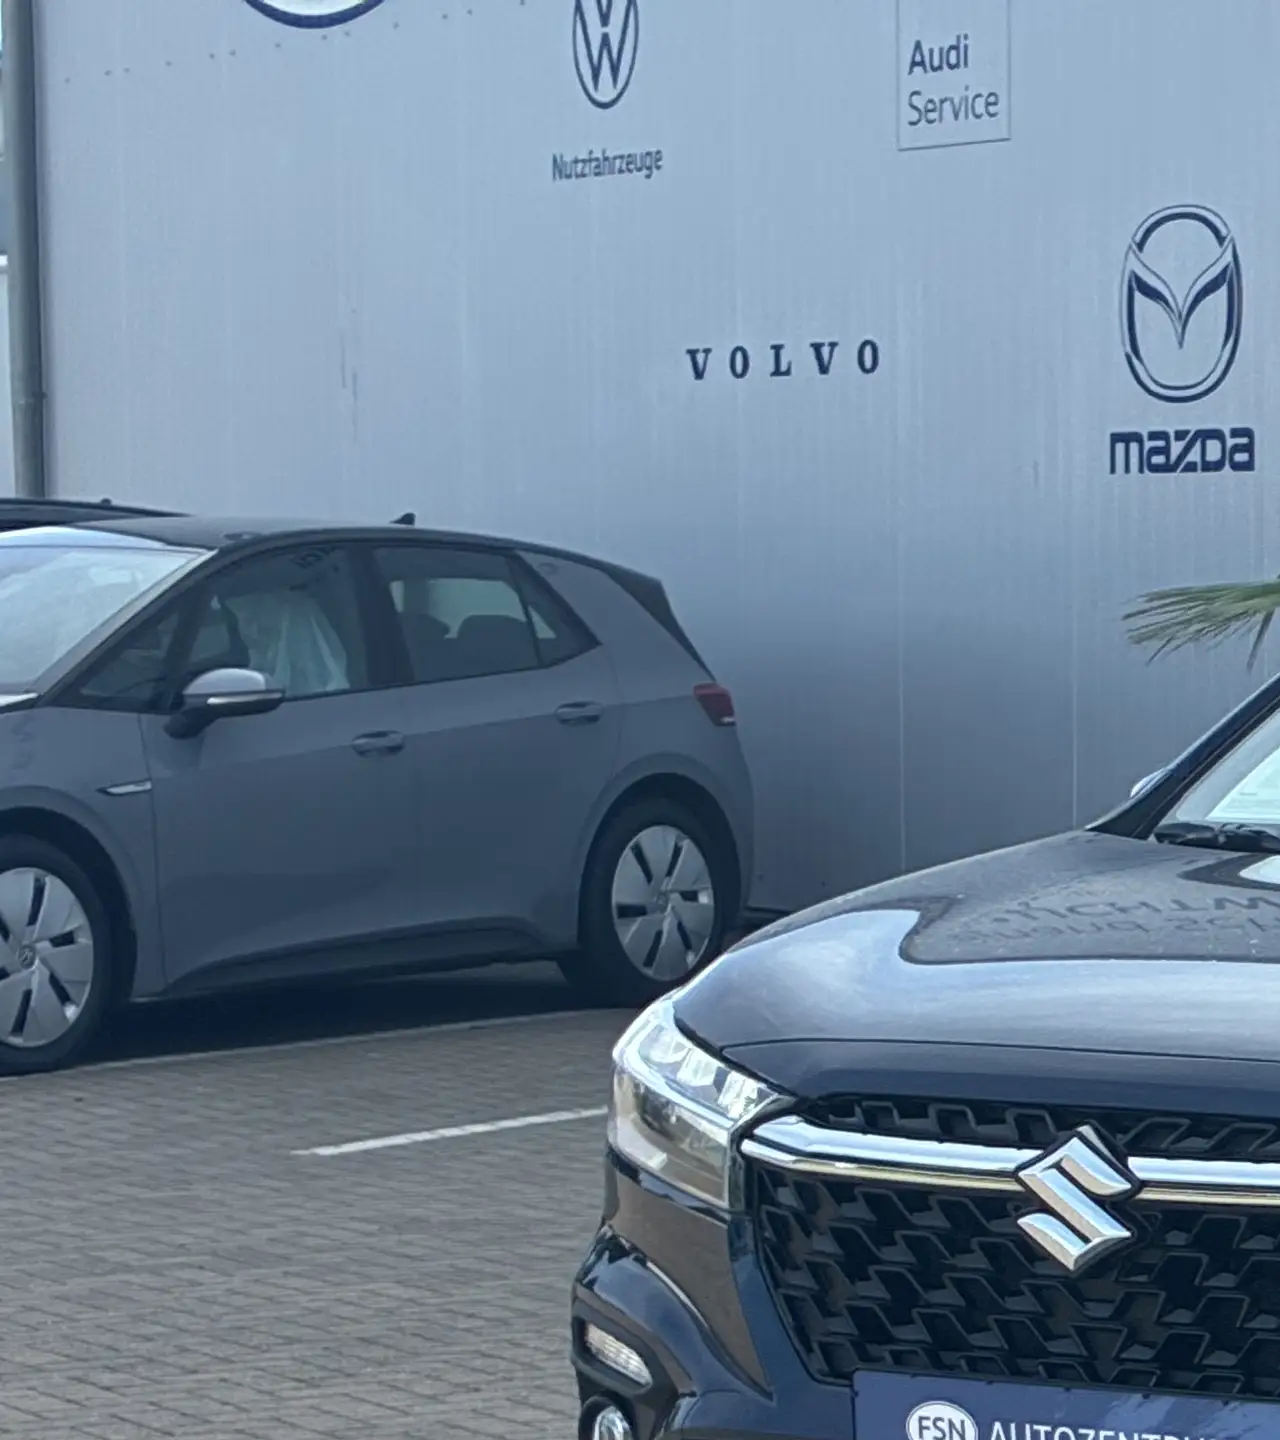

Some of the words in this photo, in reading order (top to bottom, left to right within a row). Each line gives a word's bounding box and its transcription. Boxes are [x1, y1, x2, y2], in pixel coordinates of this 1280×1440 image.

[908, 34, 969, 75] Audi
[907, 86, 1000, 126] Service
[552, 148, 663, 181] Nutzfahrzeuge
[686, 340, 880, 380] VOLVO
[1109, 427, 1256, 475] mazda
